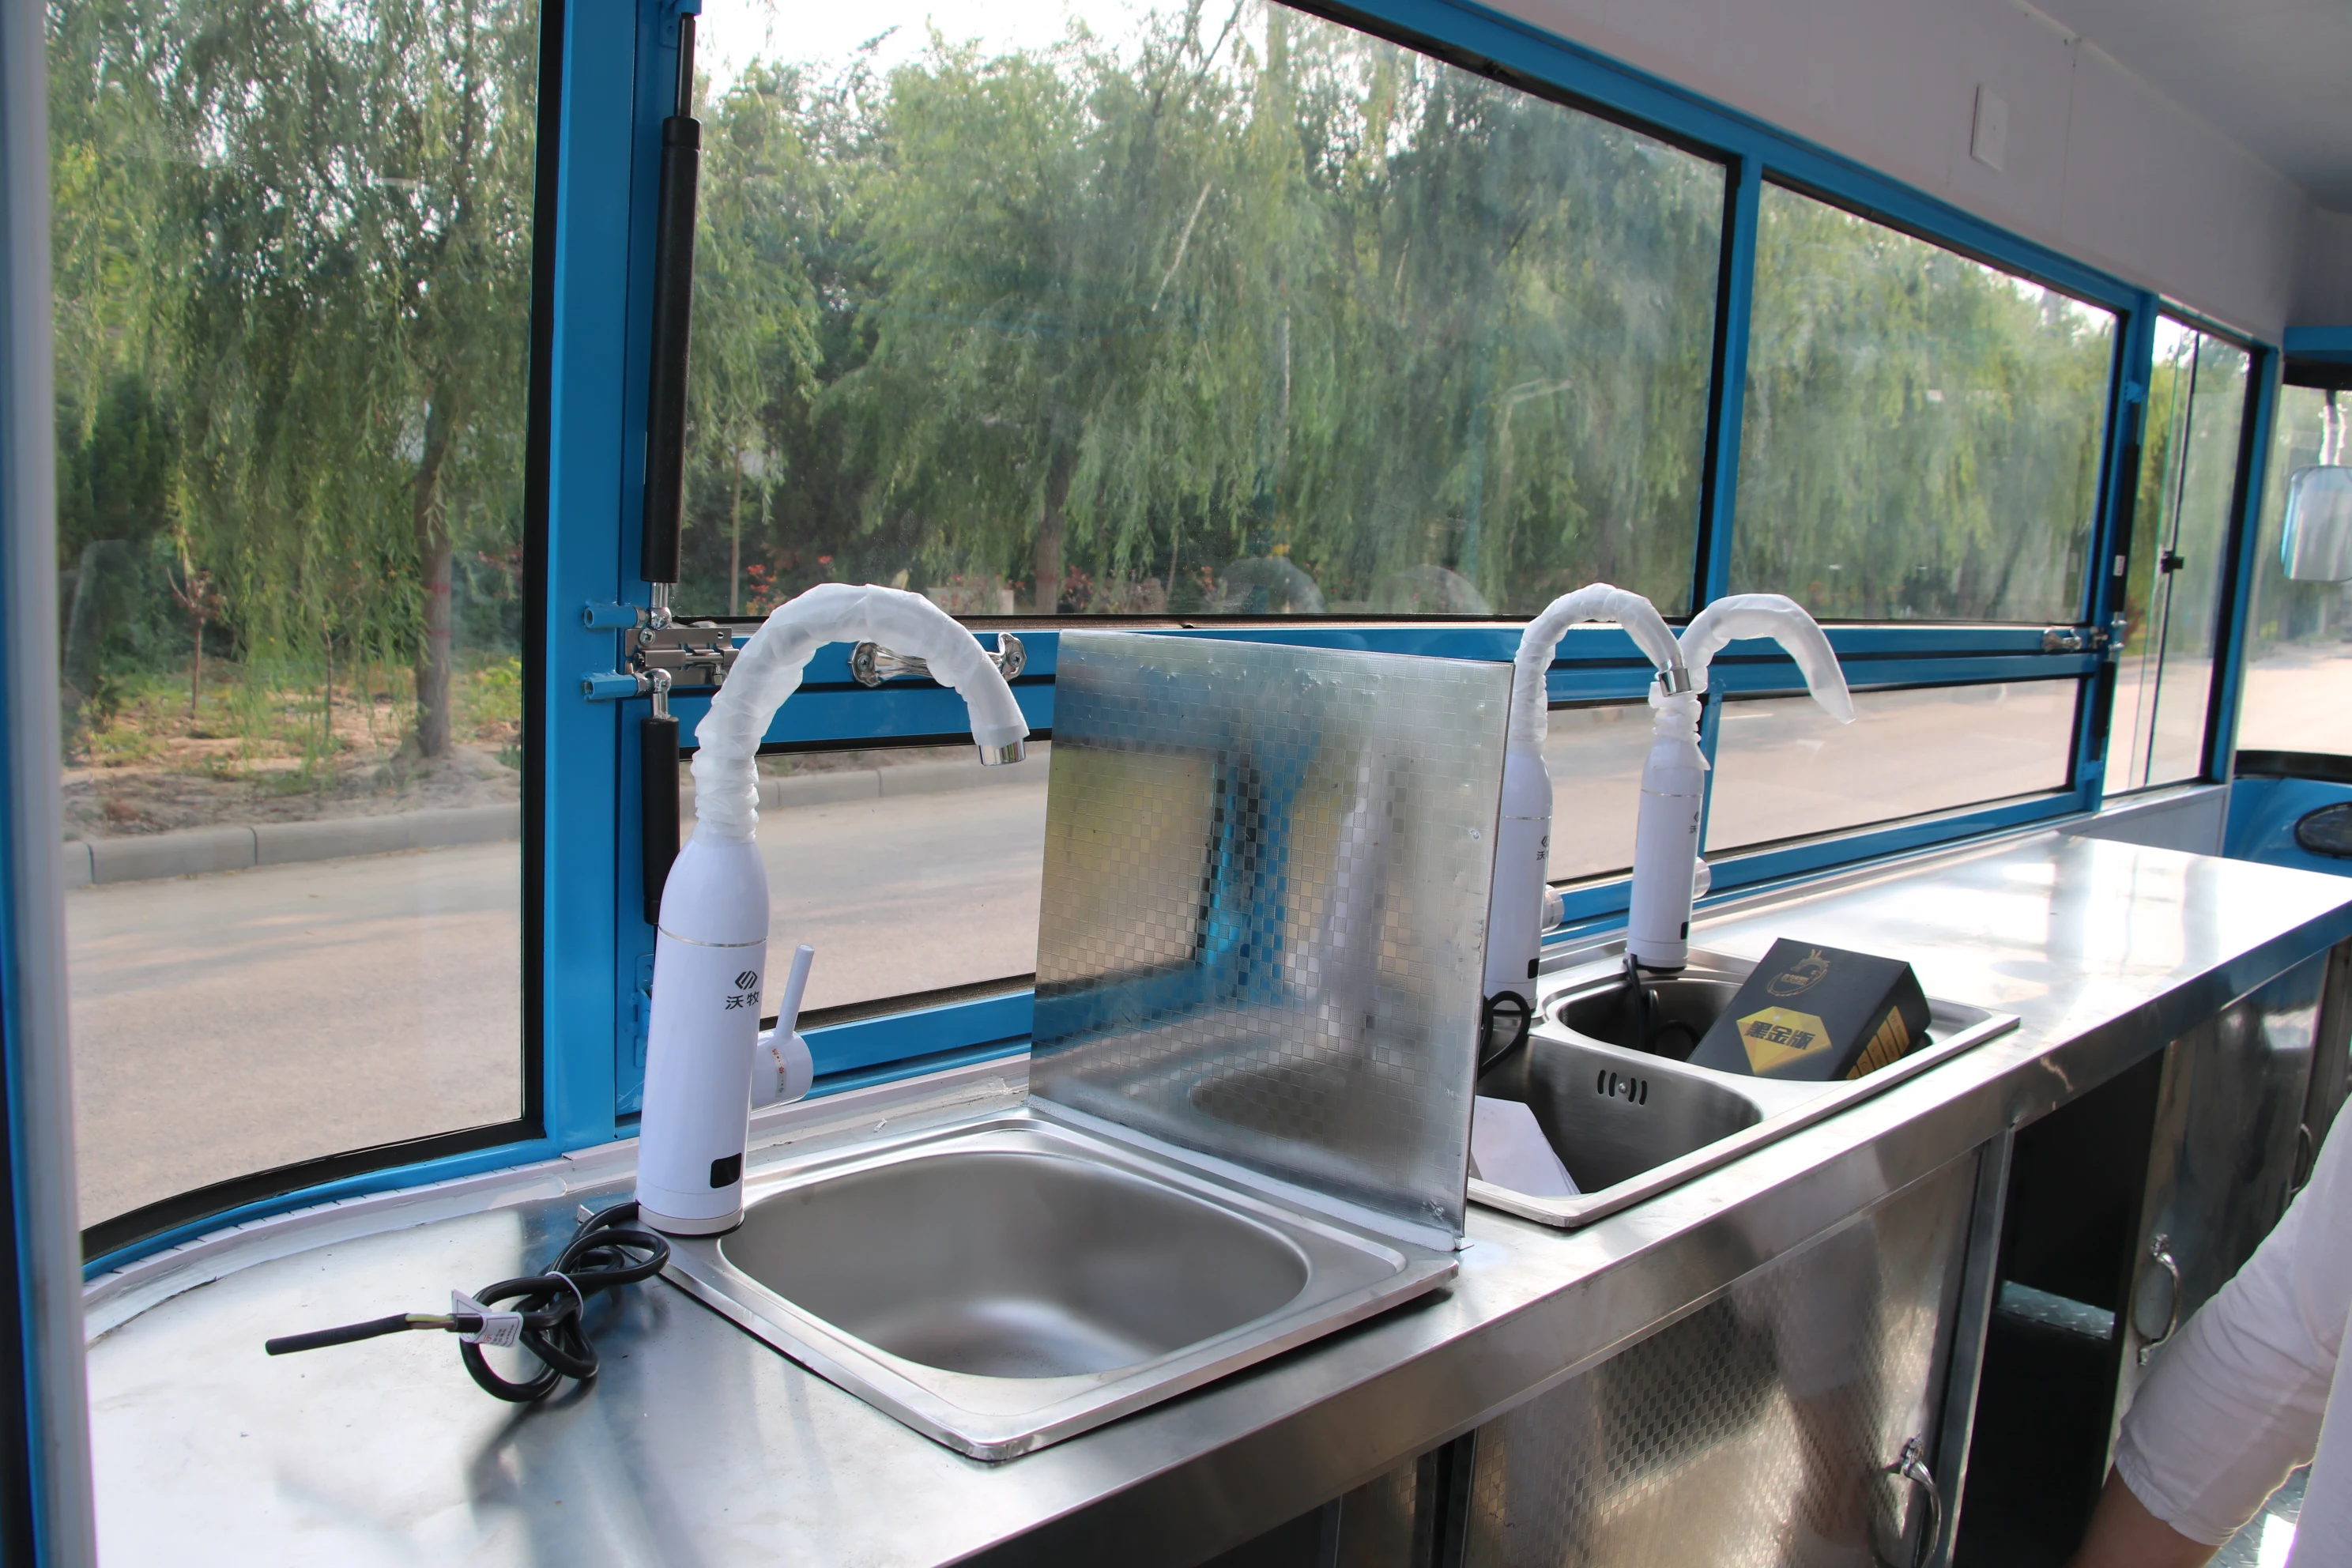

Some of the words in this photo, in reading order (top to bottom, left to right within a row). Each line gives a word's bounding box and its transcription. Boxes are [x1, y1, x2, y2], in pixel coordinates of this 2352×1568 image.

[725, 991, 760, 1010] 沃牧
[1743, 1020, 1816, 1050] 黑金版
